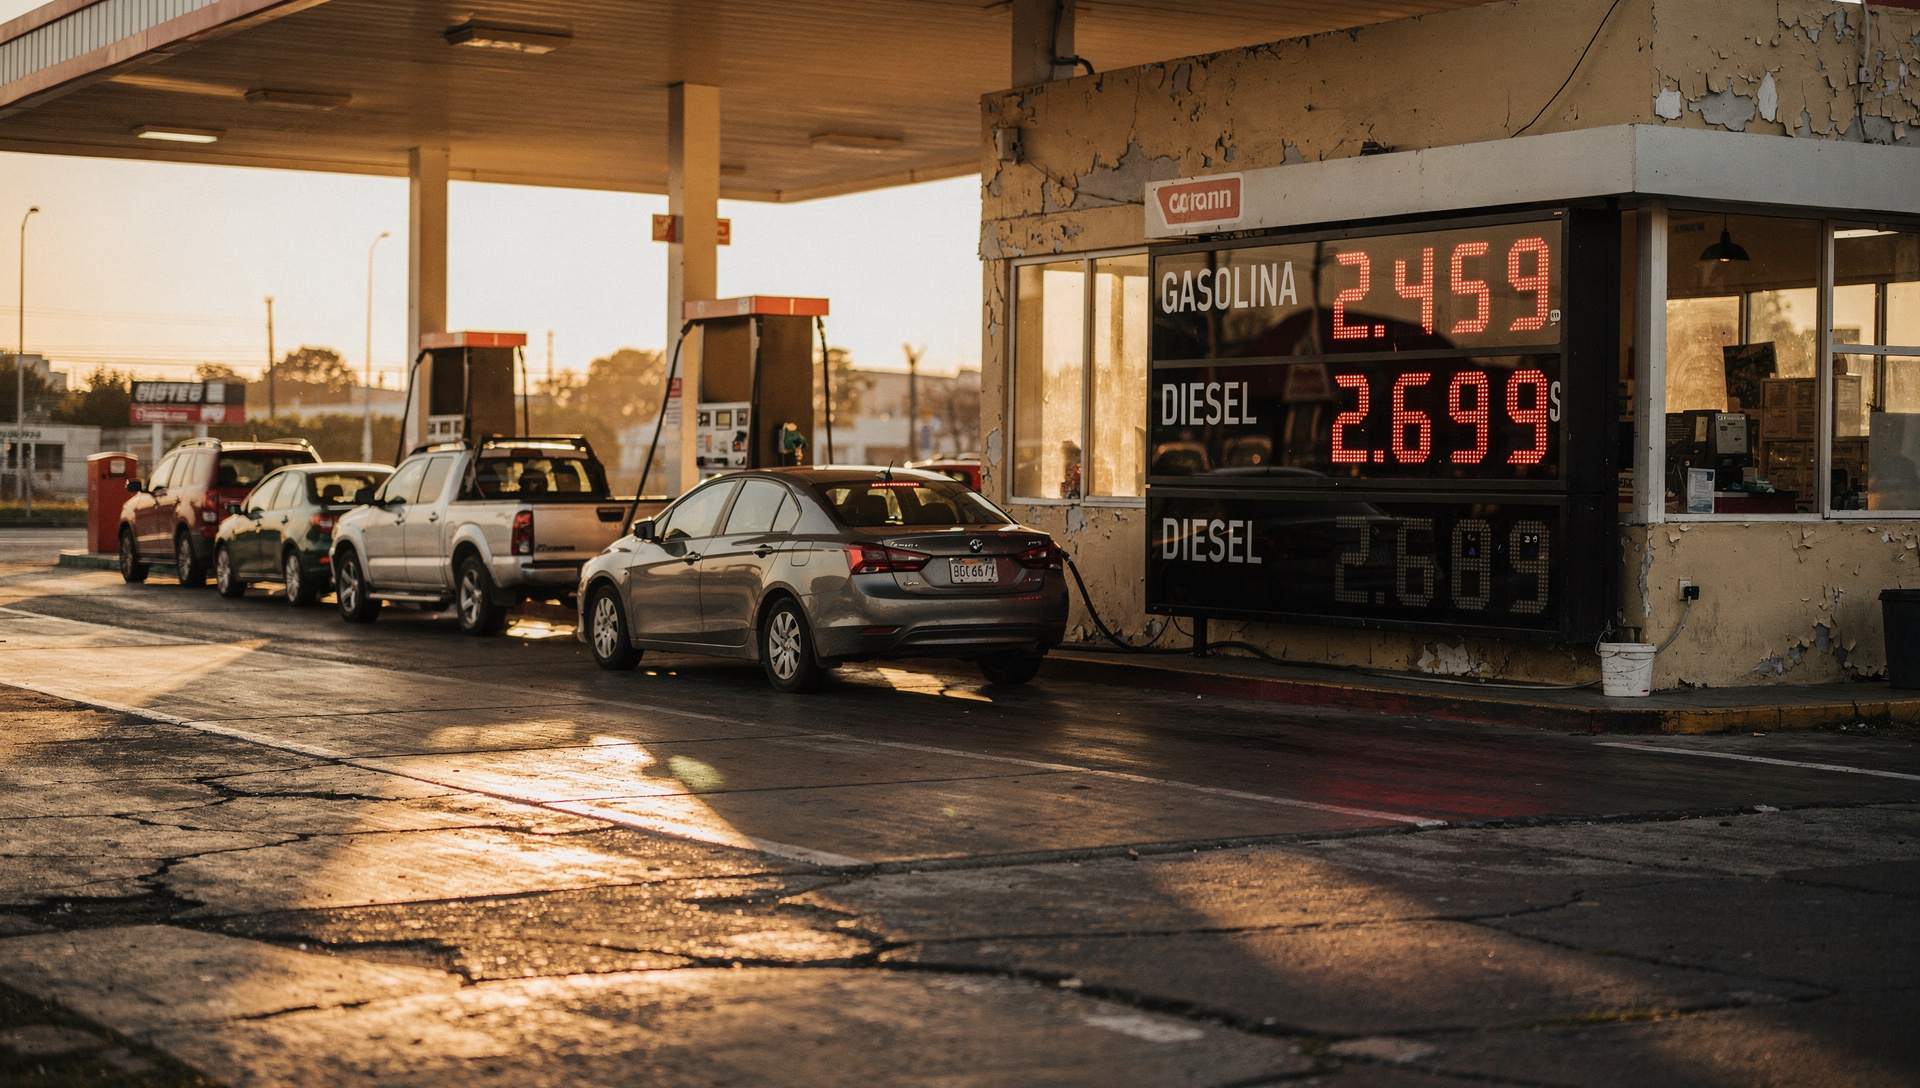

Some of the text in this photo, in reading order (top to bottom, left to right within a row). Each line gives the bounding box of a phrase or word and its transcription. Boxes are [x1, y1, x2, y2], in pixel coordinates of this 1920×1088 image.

[1161, 237, 1549, 339] GASOLINA 2.459
[1162, 381, 1257, 426] DIESEL
[1332, 369, 1548, 464] 2.699
[1162, 515, 1549, 614] DIESEL 2.689
